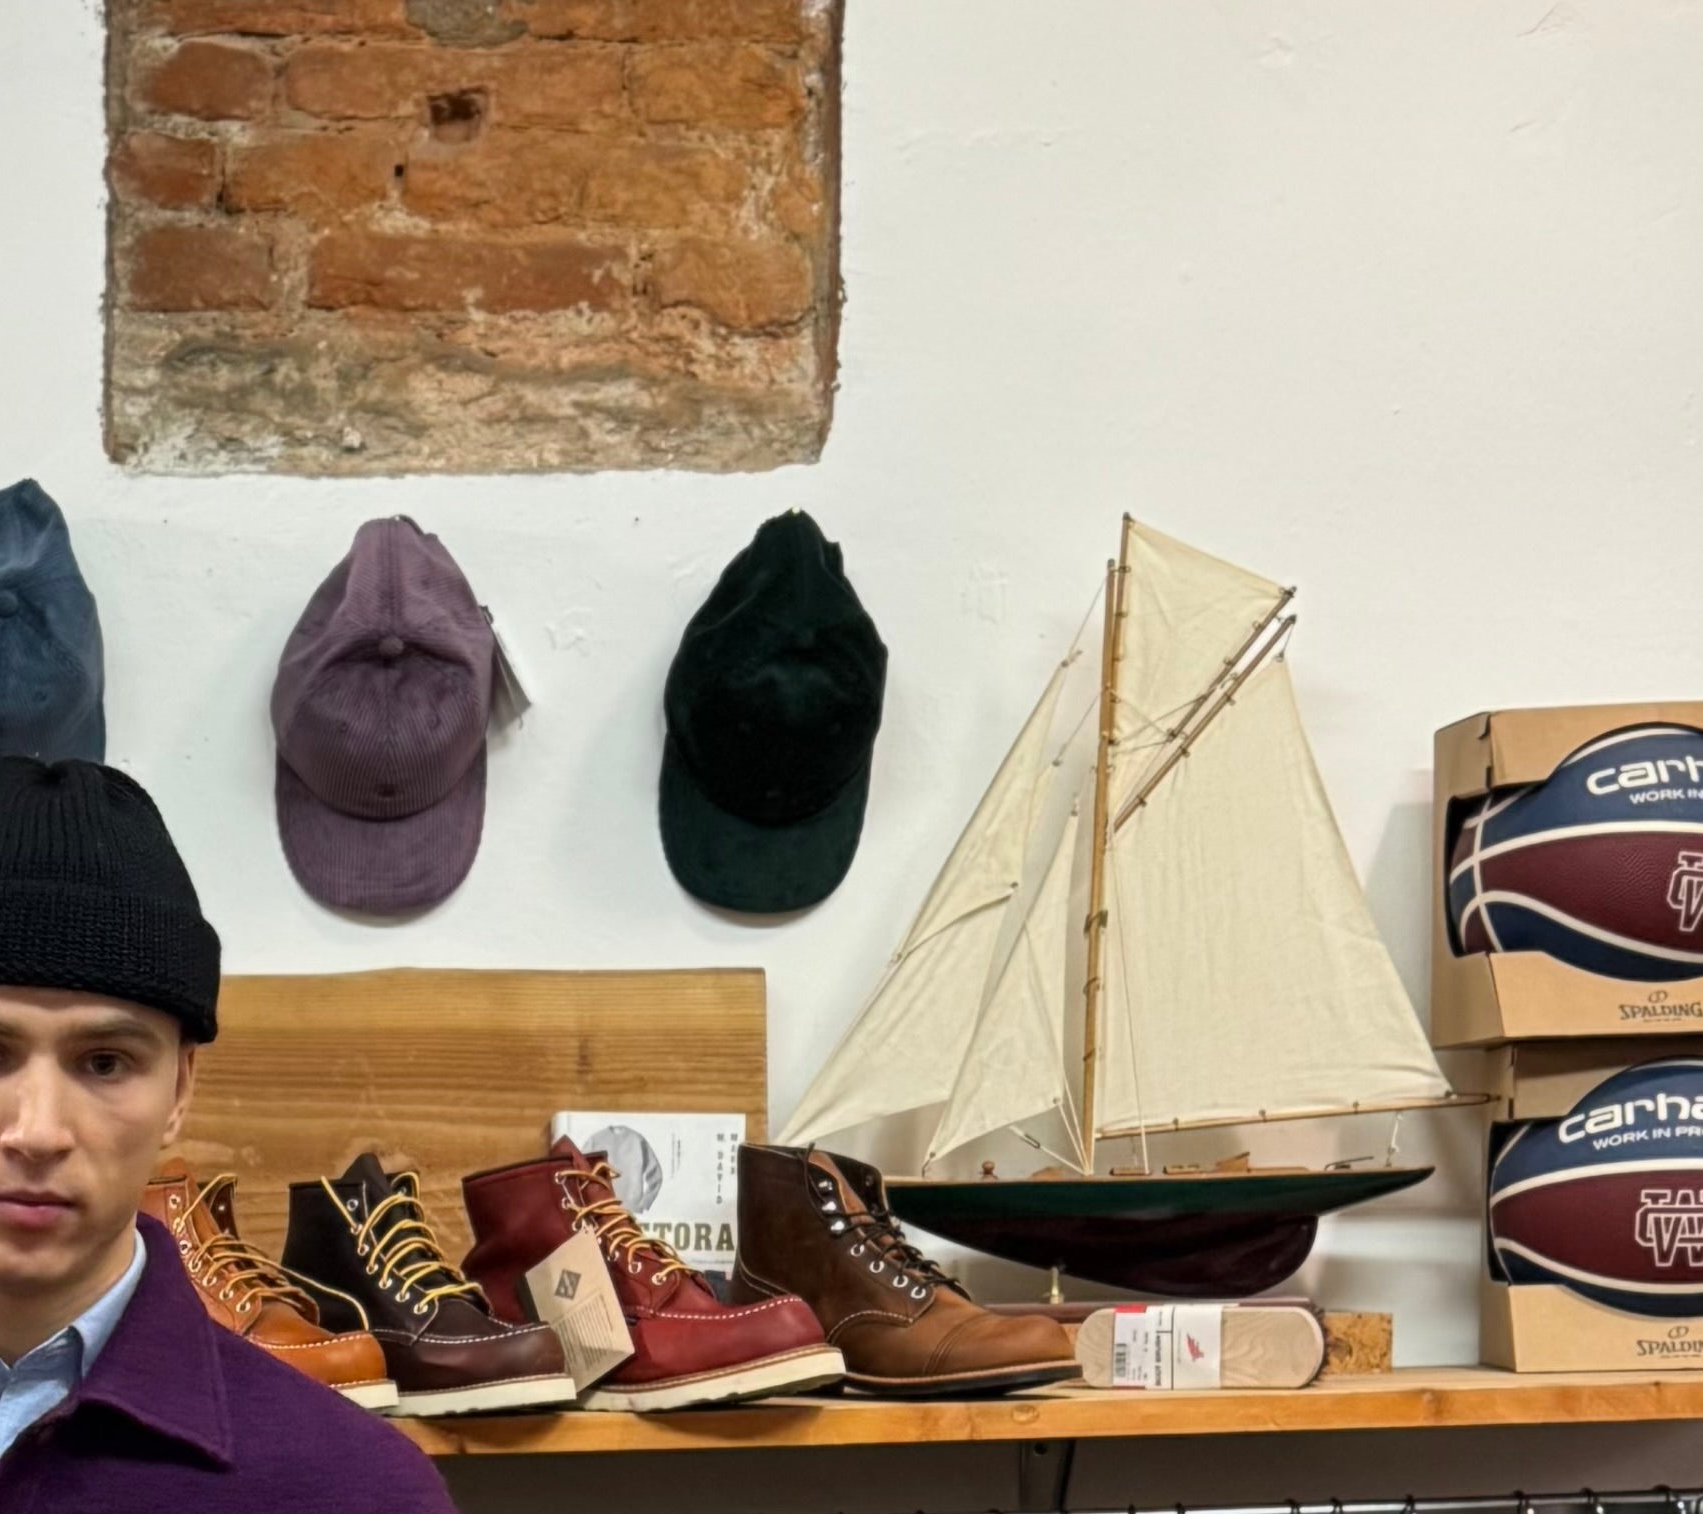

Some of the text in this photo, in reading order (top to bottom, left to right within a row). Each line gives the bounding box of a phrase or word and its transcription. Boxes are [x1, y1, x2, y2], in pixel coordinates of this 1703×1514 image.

[1629, 789, 1685, 804] WORK
[1618, 1001, 1703, 1020] SPALDING
[1592, 1130, 1649, 1150] WORK
[1652, 1127, 1672, 1139] IN
